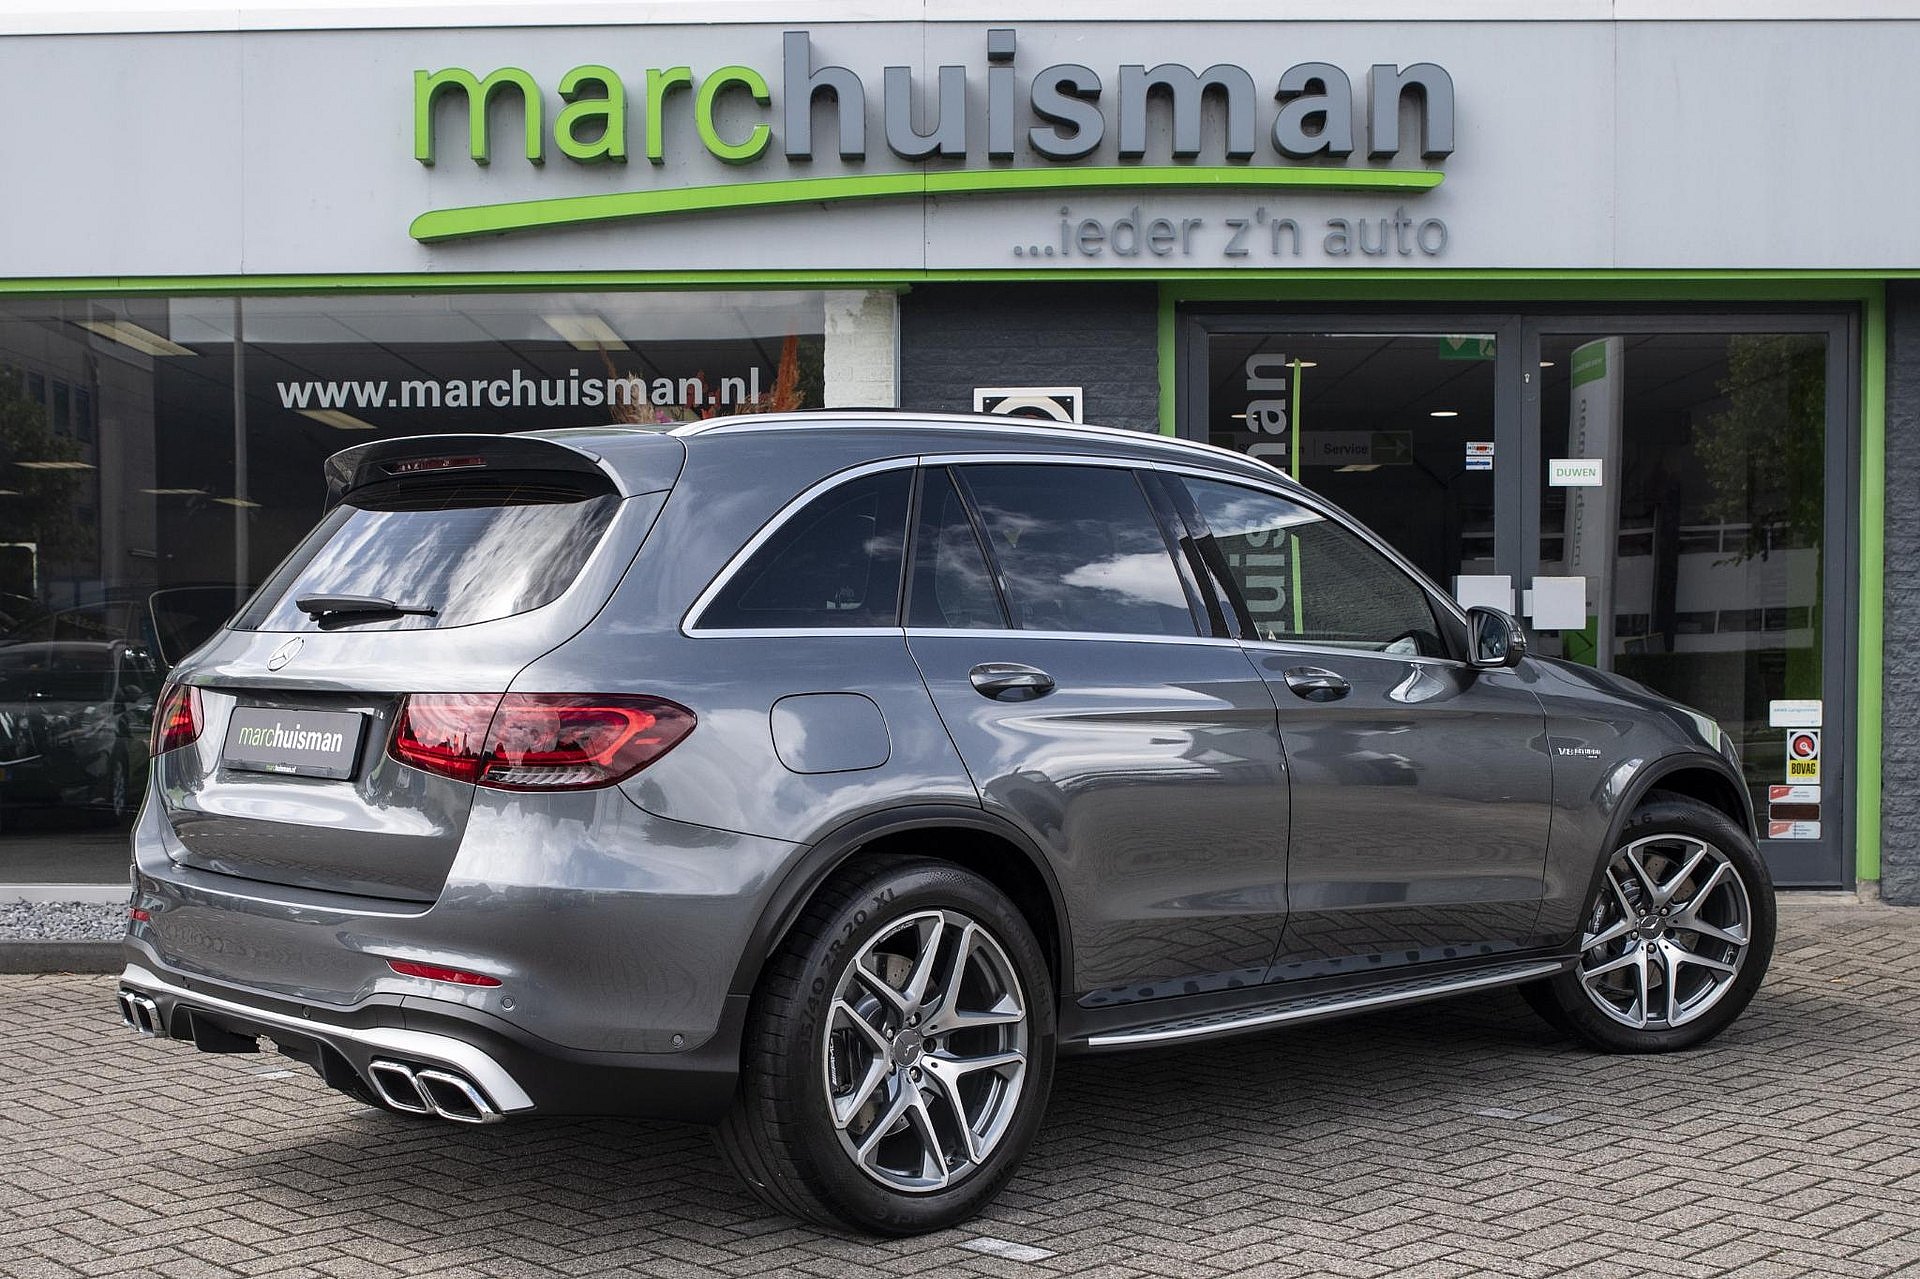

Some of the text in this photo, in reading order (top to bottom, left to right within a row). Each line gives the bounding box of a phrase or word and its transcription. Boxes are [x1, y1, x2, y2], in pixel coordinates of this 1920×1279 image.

[413, 29, 1455, 165] marchuisman
[1223, 206, 1300, 257] z'n
[1323, 206, 1449, 257] auto
[276, 367, 761, 409] www.marchuisman.nl
[1323, 443, 1369, 456] Service
[1556, 467, 1597, 478] DUWEN
[238, 721, 343, 753] marchuisman
[1791, 762, 1817, 775] BOVAG
[843, 909, 868, 939] 20
